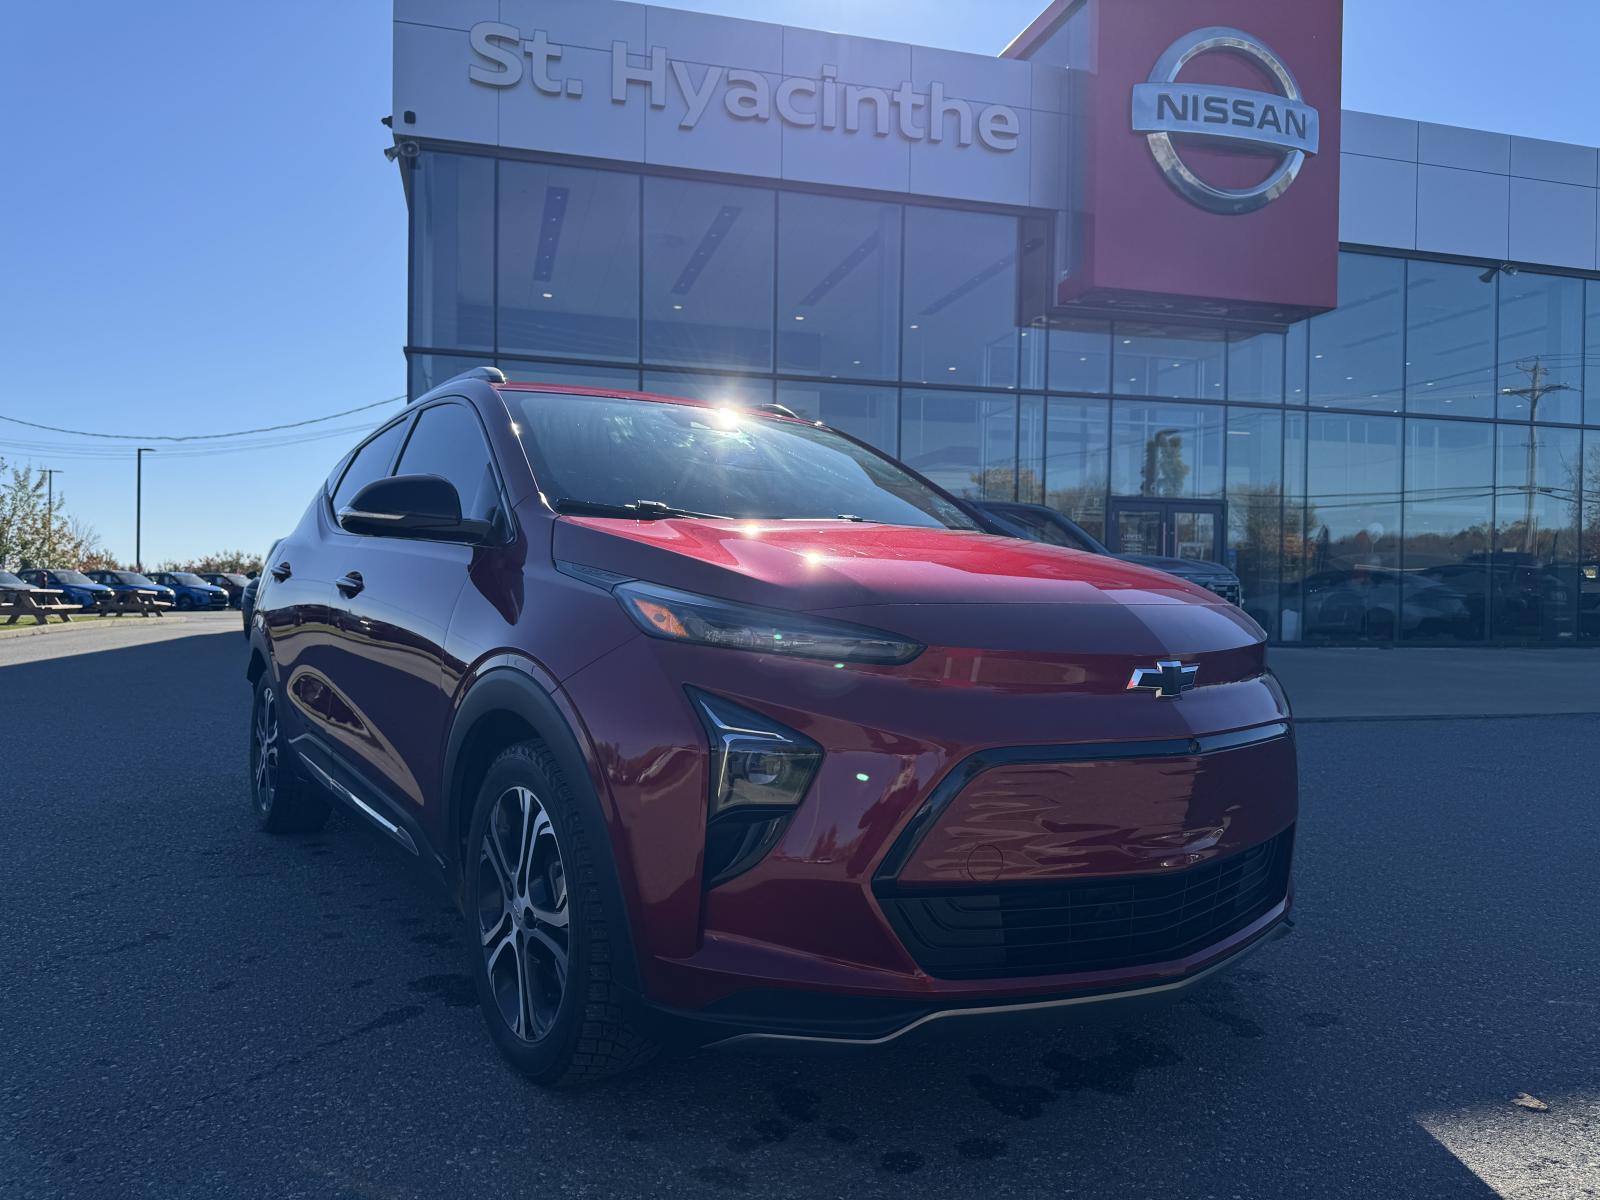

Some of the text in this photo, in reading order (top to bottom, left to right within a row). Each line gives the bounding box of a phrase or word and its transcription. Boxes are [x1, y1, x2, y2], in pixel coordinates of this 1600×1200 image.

[468, 20, 1020, 151] St. Hyacinthe
[1156, 92, 1307, 140] NISSAN
